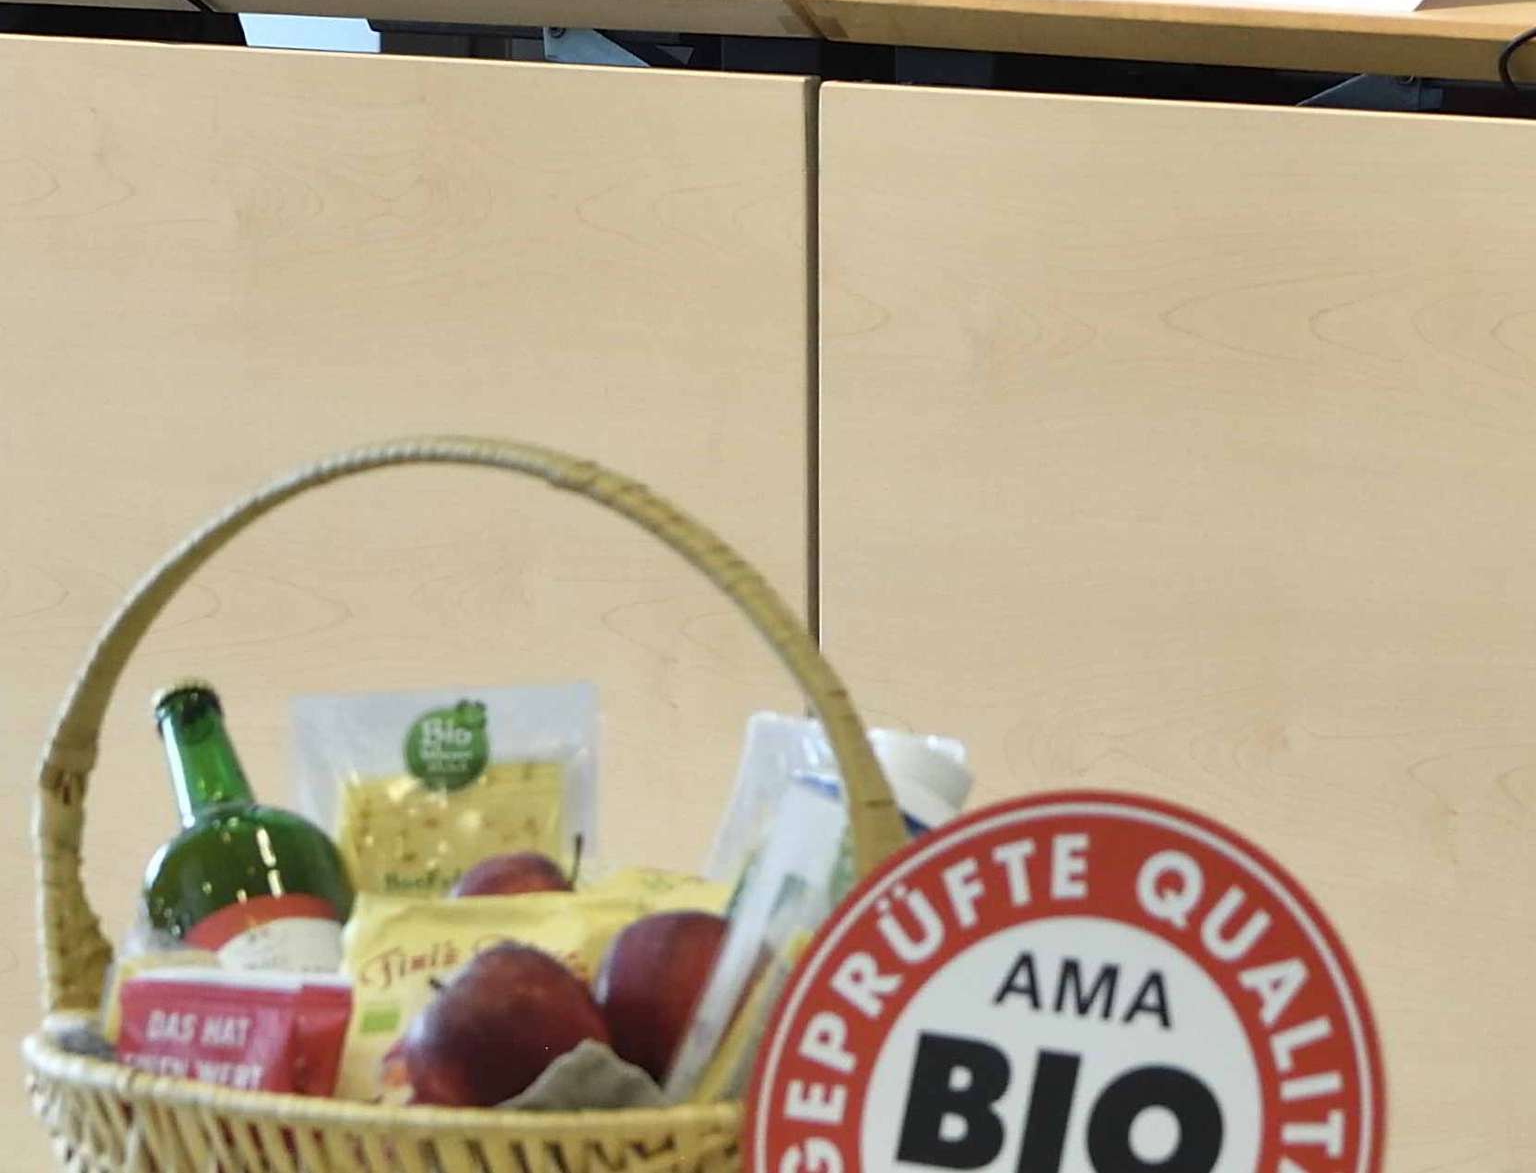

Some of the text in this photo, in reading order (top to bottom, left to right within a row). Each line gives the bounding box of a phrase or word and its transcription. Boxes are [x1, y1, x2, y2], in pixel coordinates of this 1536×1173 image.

[146, 1010, 252, 1047] DAS HAT
[779, 833, 1344, 1173] GEPRÜFTE QUALIT
[993, 949, 1172, 1030] AMA
[896, 1031, 1225, 1173] BIO
